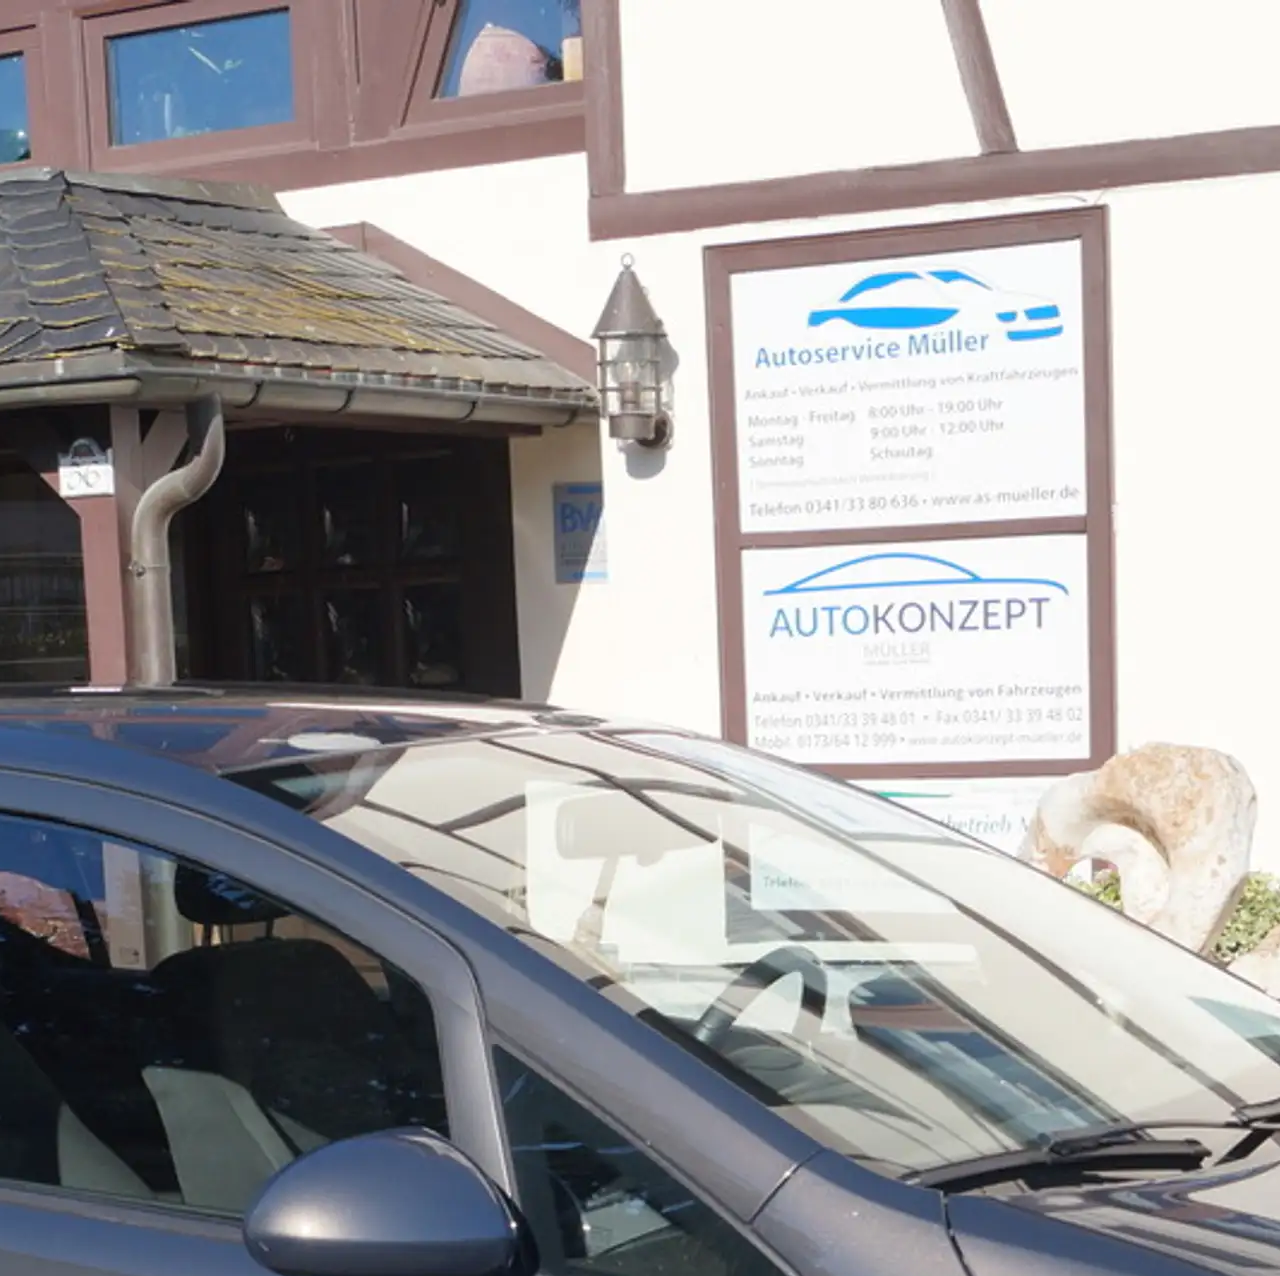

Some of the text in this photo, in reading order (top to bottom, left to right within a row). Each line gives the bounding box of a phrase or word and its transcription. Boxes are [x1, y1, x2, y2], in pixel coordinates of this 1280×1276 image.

[754, 330, 990, 369] Autoservice Müller
[744, 365, 1079, 401] Ankauf Verkauf Vermittlung von Kraftfahrzeugen
[747, 413, 799, 429] Montag
[808, 409, 857, 425] Freitag
[899, 403, 926, 417] Uhr
[977, 397, 1004, 413] Uhr
[748, 433, 805, 450] Samstag
[901, 424, 928, 439] Uhr
[979, 418, 1004, 434] Uhr
[748, 445, 934, 469] Sonntag Schautag
[749, 501, 802, 517] Telefon
[890, 493, 919, 510] 636
[769, 596, 1051, 638] AUTOKONZEPT
[862, 638, 931, 659] MÜLLER
[752, 683, 1083, 704] Ankauf Verkauf Vermittlung von Fahrzeugen
[754, 713, 803, 729] Telefon
[935, 710, 960, 726] Fax
